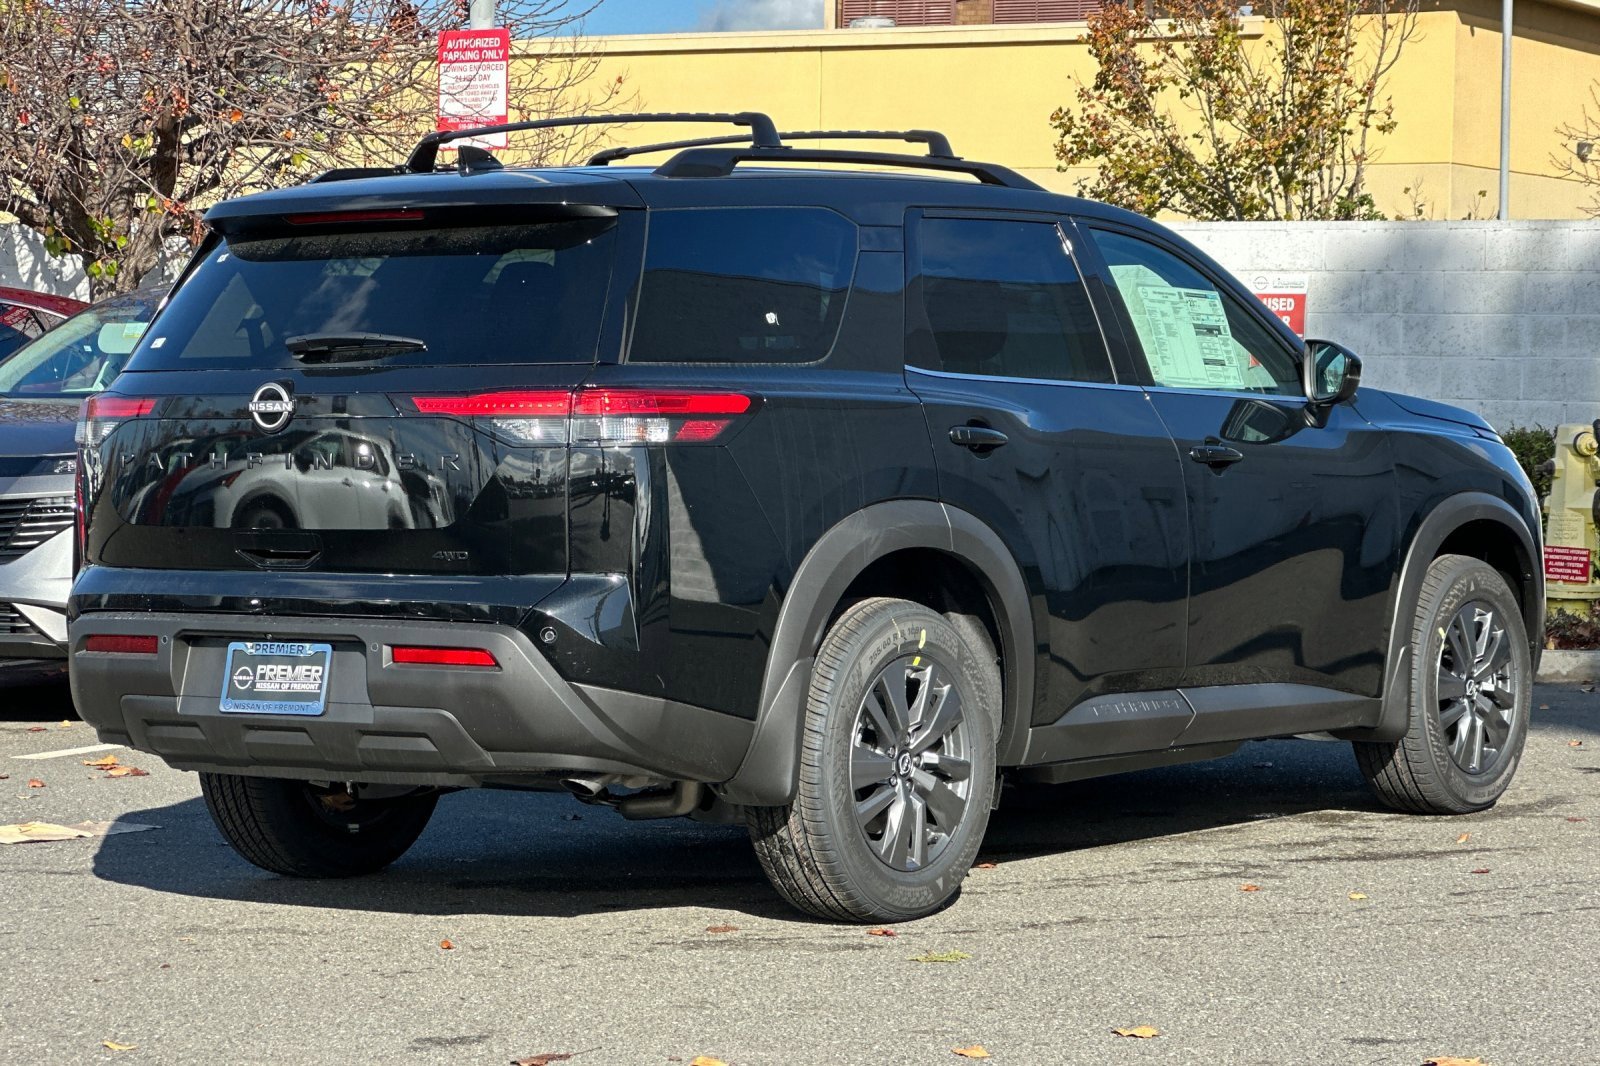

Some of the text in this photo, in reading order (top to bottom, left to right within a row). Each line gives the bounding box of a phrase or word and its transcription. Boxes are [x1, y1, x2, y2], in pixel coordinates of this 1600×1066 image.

[447, 38, 500, 49] AUTHORIZED
[442, 49, 505, 60] PARKING ONLY
[442, 63, 505, 73] TOWING ENFORCED
[478, 73, 491, 81] DAY
[249, 402, 291, 411] NISSAN
[119, 451, 462, 471] PATHFINDER
[431, 550, 469, 560] 4WD
[254, 643, 305, 654] PREMIER
[255, 664, 323, 682] PREMIER
[233, 702, 310, 712] NISSAN OF FREMONT
